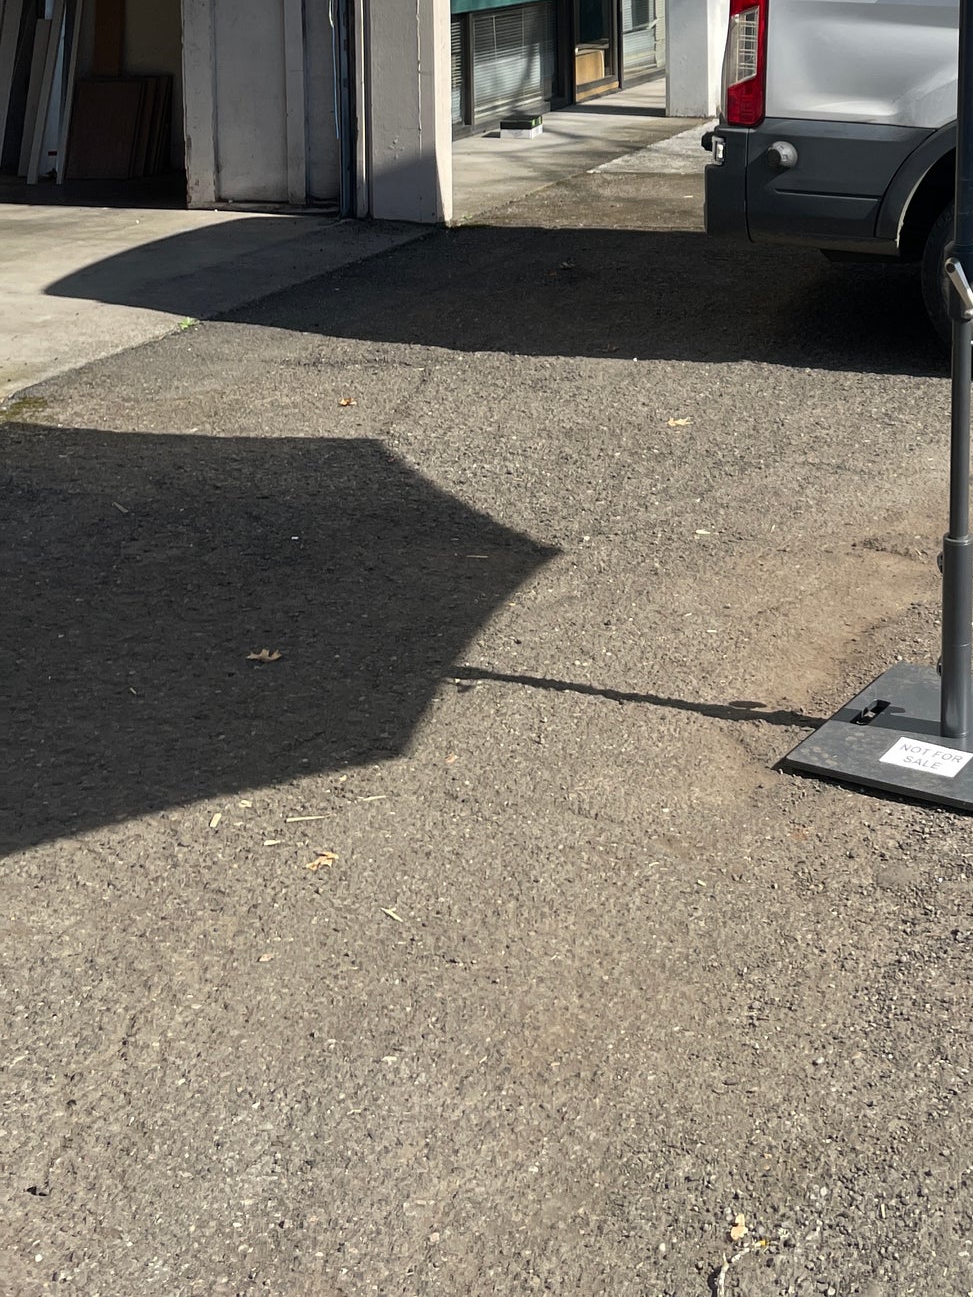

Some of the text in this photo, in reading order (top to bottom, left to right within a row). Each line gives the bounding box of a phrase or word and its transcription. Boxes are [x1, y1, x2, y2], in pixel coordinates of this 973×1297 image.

[899, 743, 963, 763] NOT FOR
[903, 755, 943, 769] SALE
